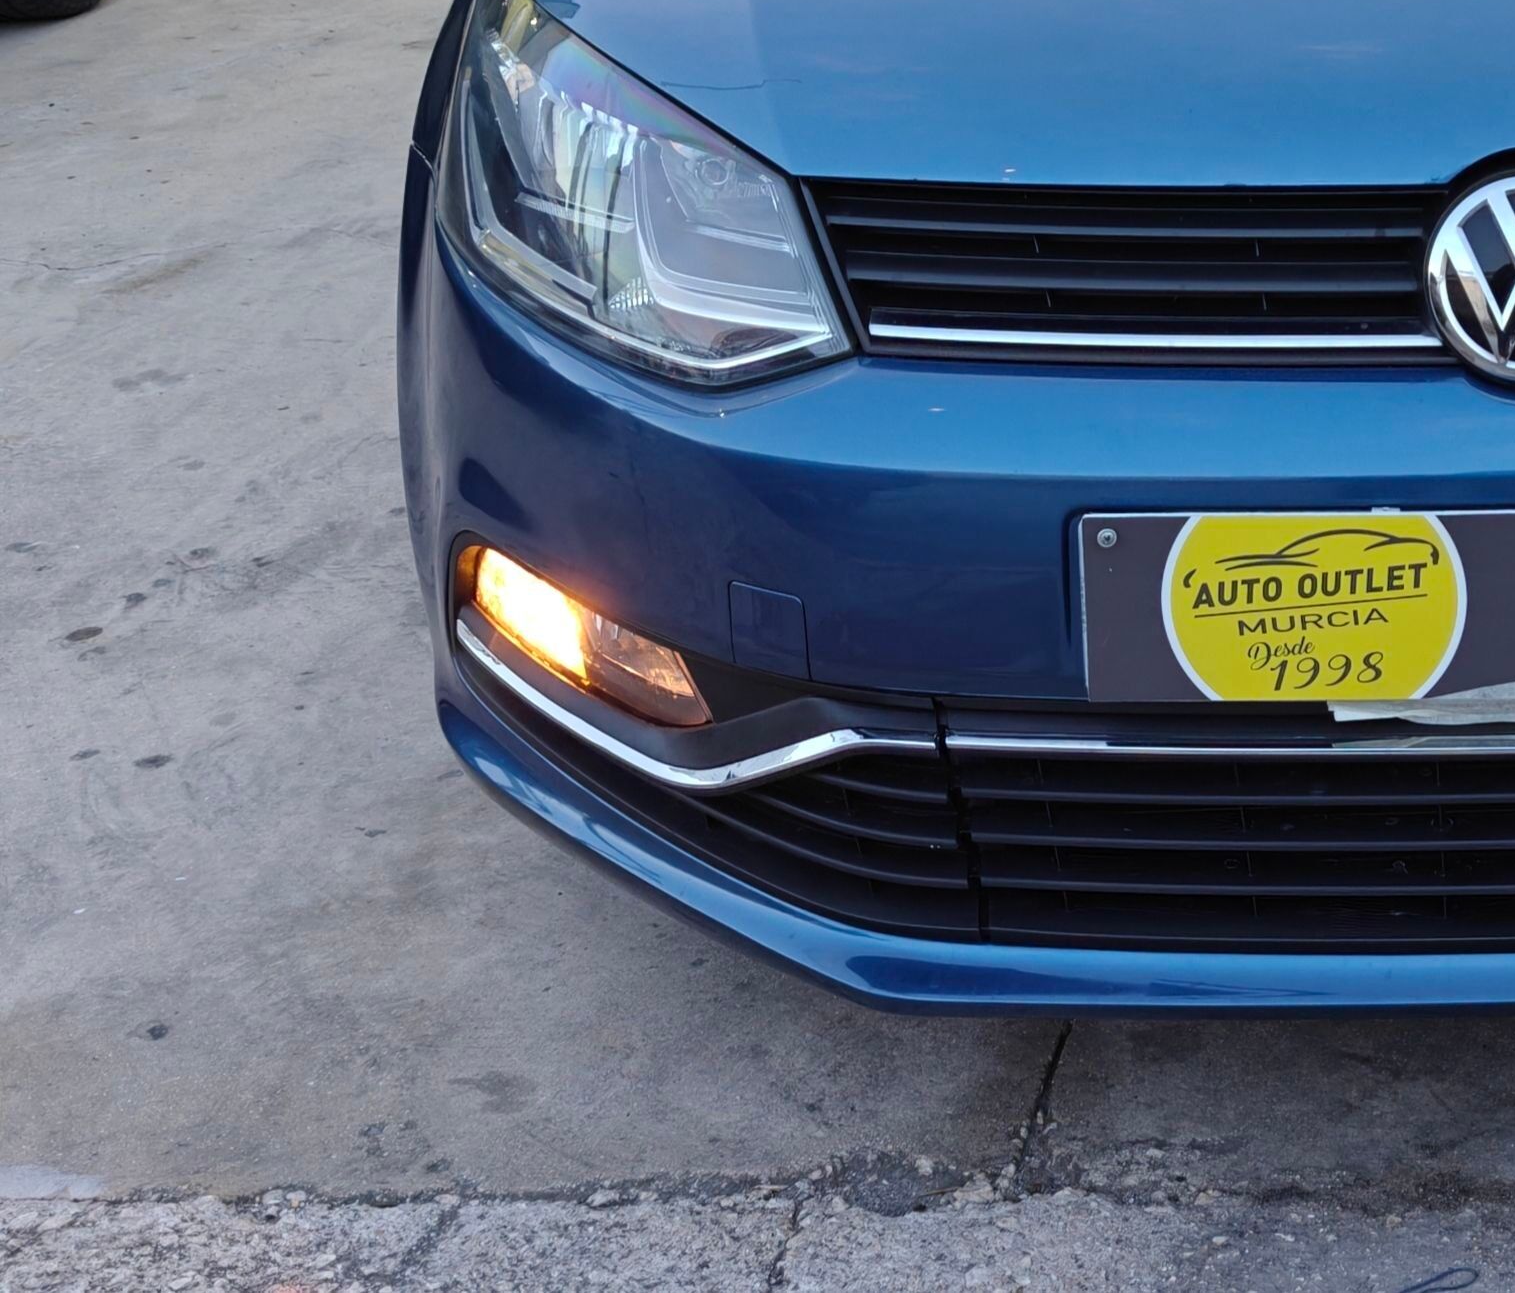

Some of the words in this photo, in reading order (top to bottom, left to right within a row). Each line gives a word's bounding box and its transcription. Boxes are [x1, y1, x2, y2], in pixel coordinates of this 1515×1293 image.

[1192, 576, 1283, 610] AUTO
[1297, 562, 1428, 599] OUTLET
[1238, 608, 1389, 636] MURCIA
[1247, 636, 1316, 671] Desde
[1270, 651, 1384, 692] 1998
